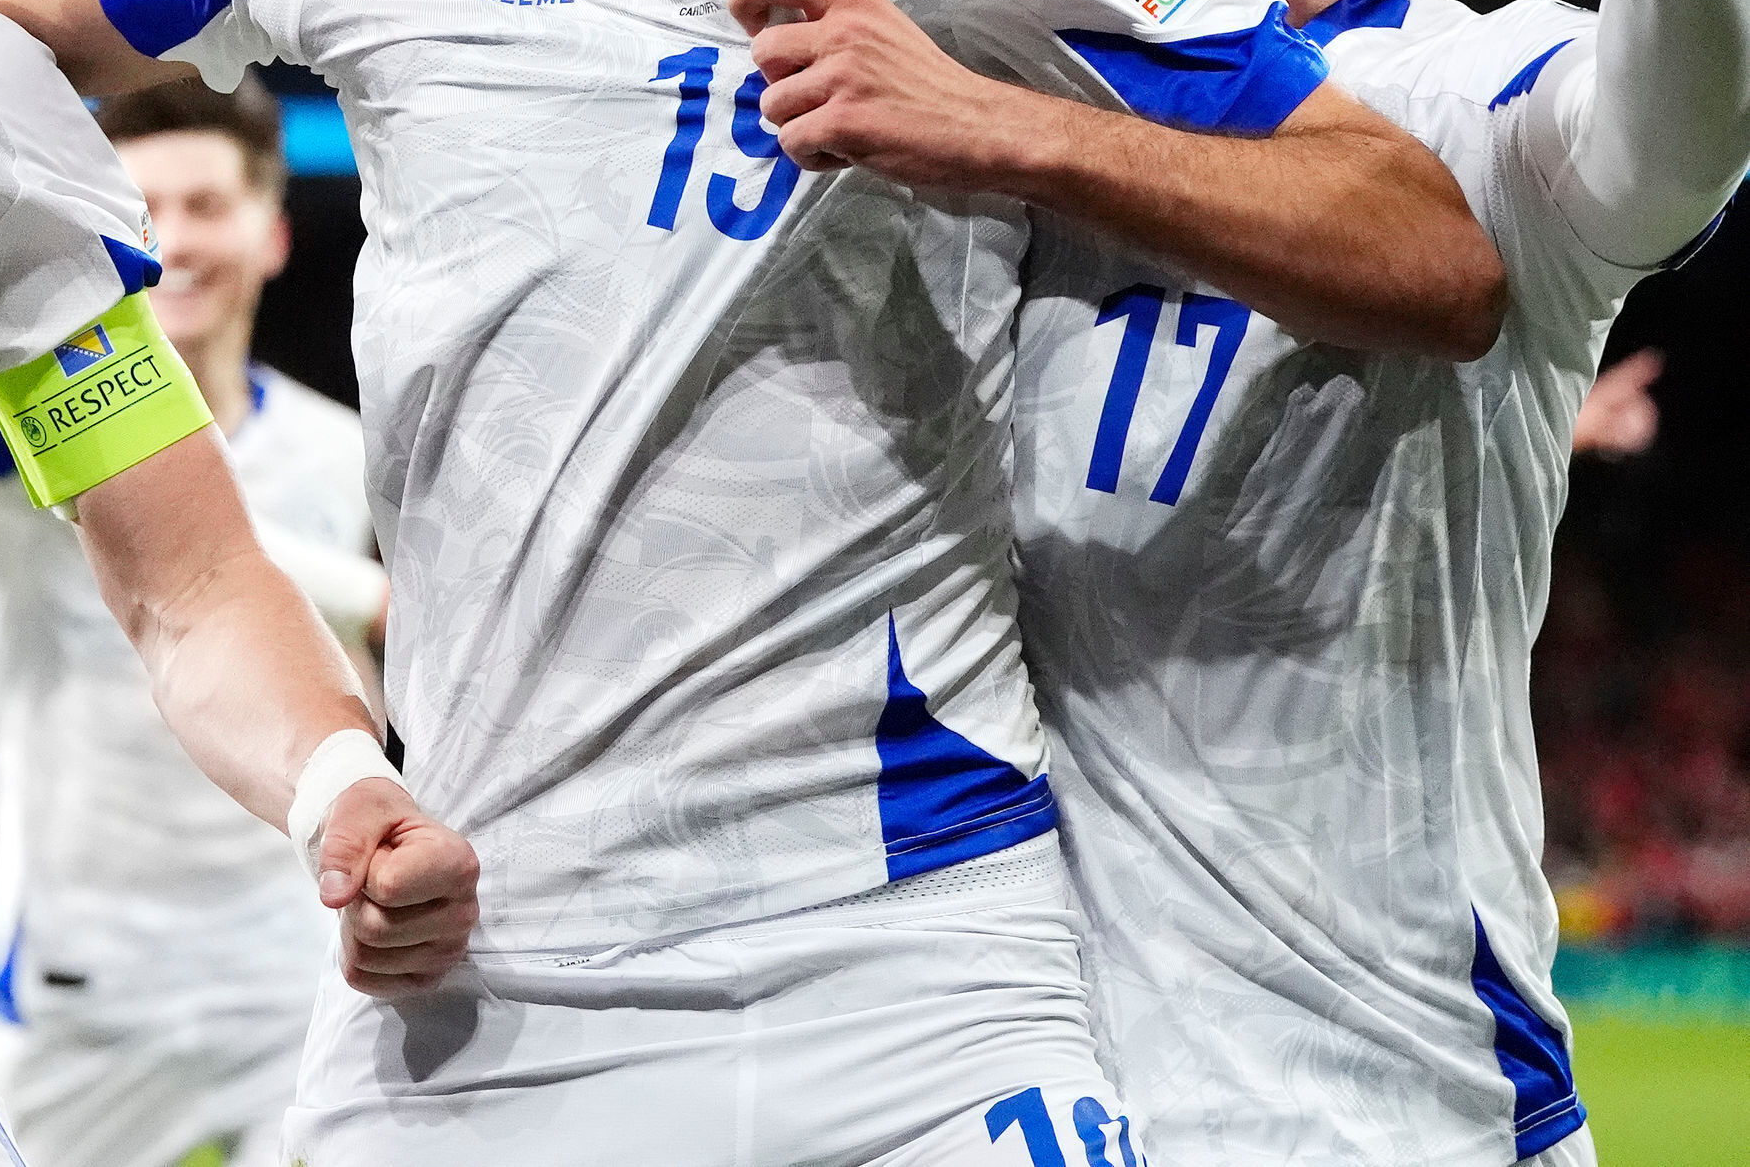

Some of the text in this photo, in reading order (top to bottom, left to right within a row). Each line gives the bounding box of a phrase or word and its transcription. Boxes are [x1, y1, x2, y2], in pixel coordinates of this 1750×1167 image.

[647, 46, 802, 242] 19
[47, 354, 162, 433] RESPECT
[1085, 282, 1252, 507] 17
